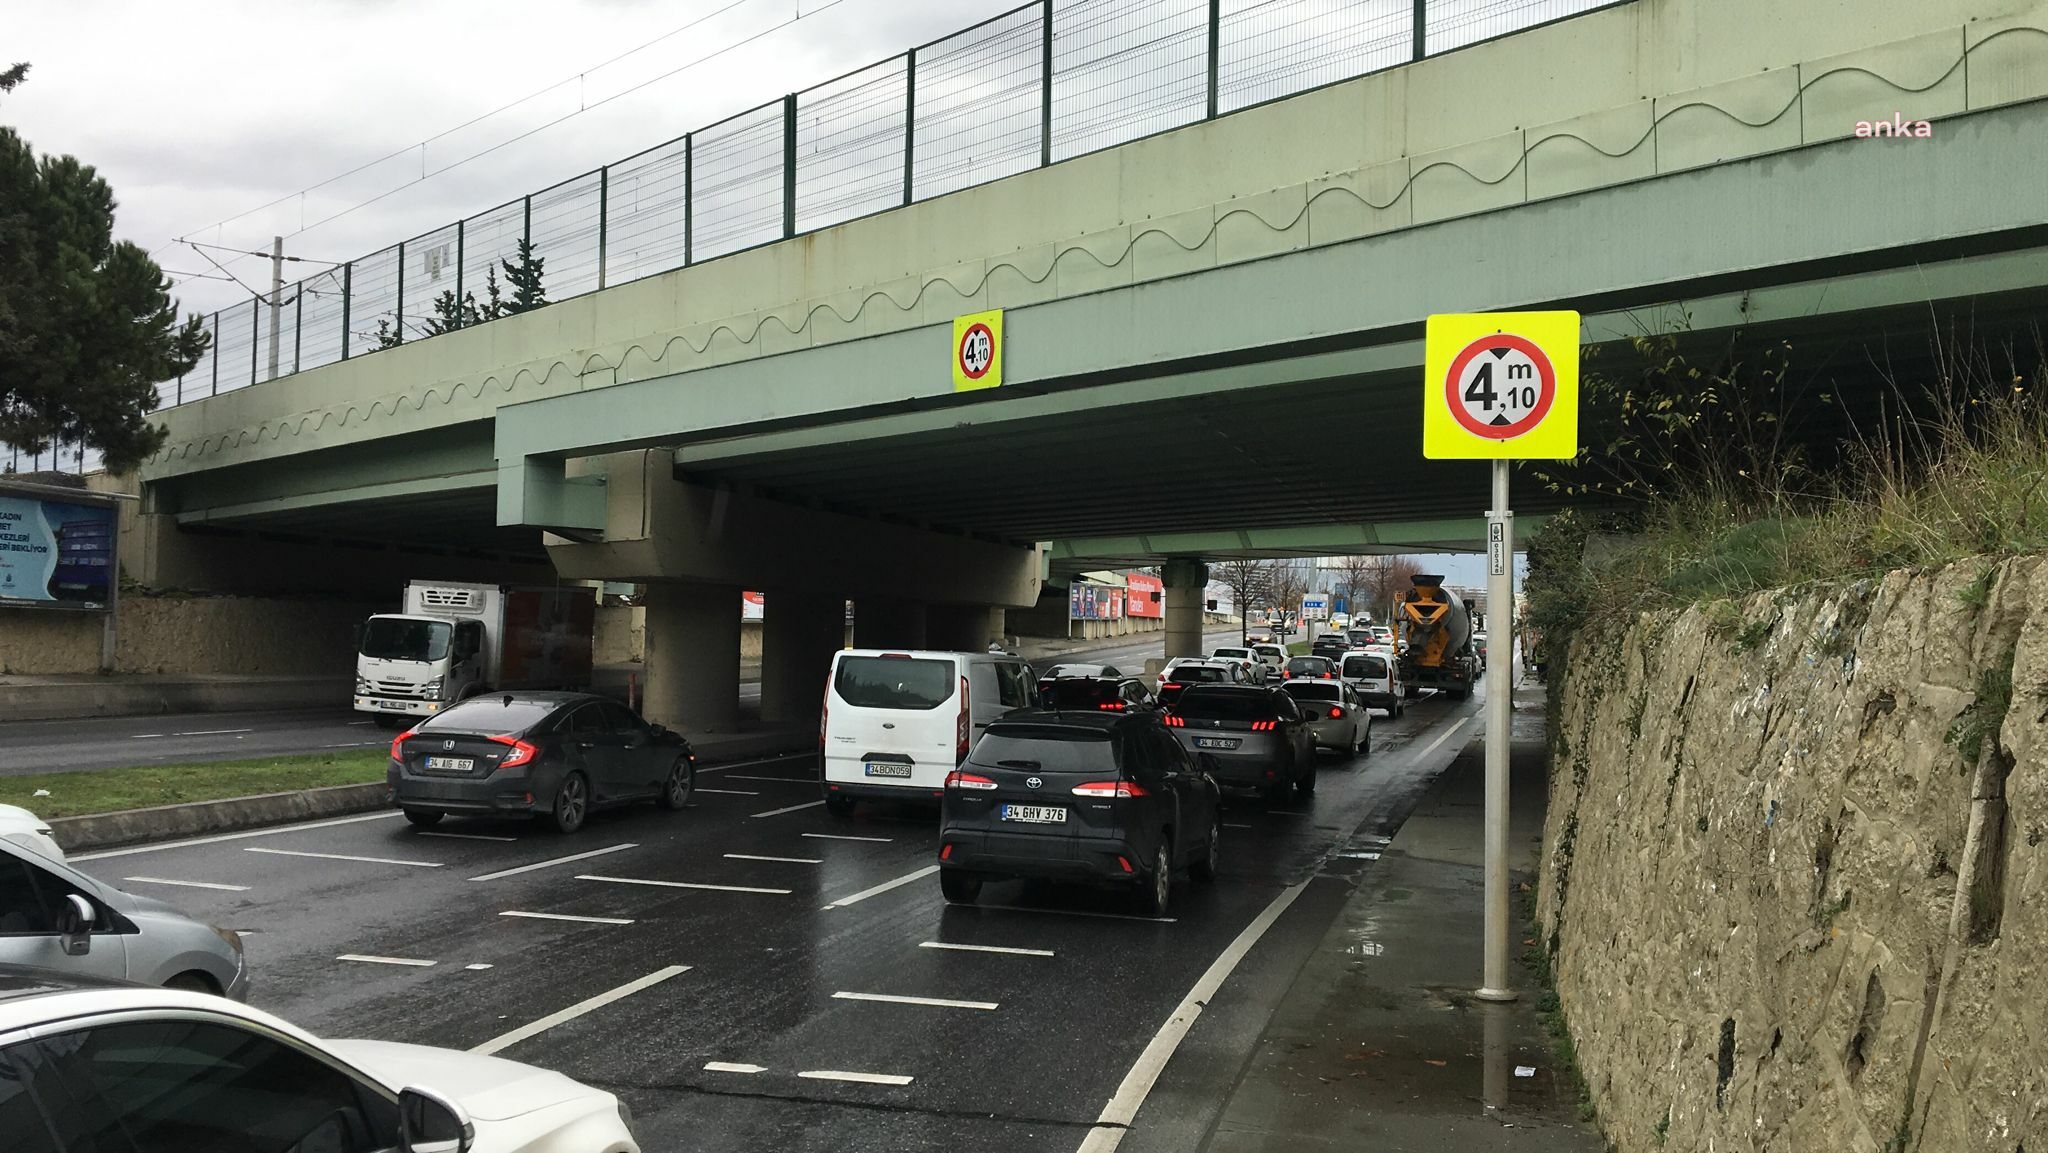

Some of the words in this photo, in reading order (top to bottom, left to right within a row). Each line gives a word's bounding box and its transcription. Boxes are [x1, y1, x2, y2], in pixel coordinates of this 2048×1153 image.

[1508, 363, 1532, 379] m
[428, 758, 438, 767] 34
[1007, 806, 1019, 817] 34
[1022, 807, 1041, 819] GHV
[1045, 808, 1064, 820] 376
